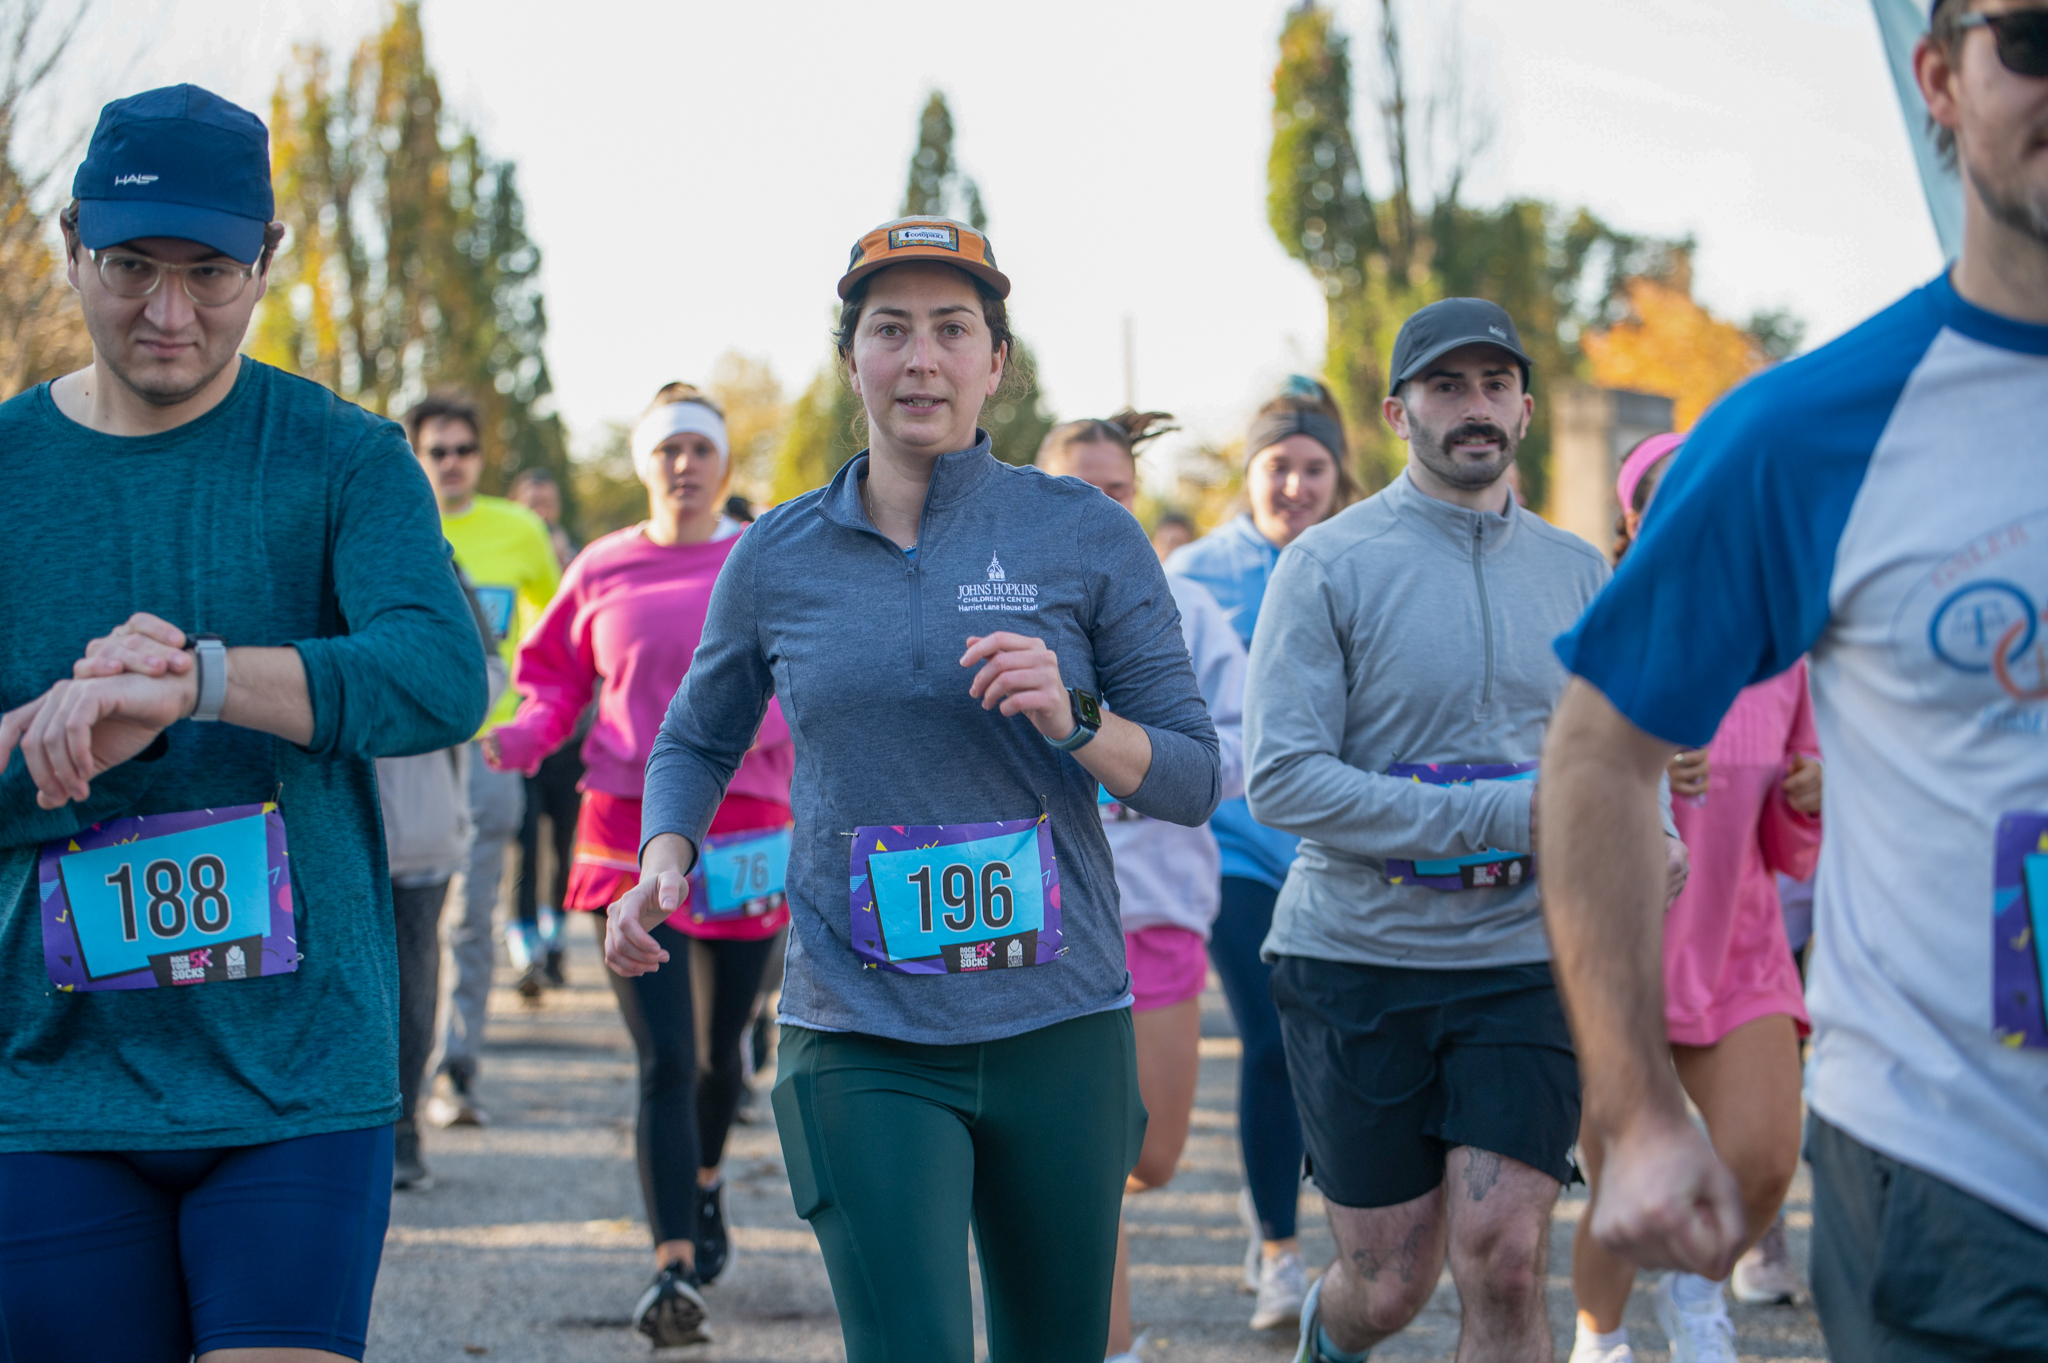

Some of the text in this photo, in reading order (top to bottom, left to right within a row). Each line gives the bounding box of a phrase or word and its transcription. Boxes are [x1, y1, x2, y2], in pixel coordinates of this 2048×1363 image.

[957, 583, 1039, 600] JOHNS HOPKINS
[962, 595, 1005, 603] CHILDREN'S
[958, 603, 983, 612] Harriet
[1001, 603, 1021, 611] House
[1022, 603, 1039, 611] Staff
[730, 851, 769, 898] 76
[105, 853, 231, 942] 188
[907, 860, 1014, 933] 196
[960, 946, 976, 954] ROCK
[976, 941, 996, 958] 5K
[189, 948, 214, 969] 5K
[960, 957, 988, 968] SOCKS
[171, 967, 206, 981] SOCKS
